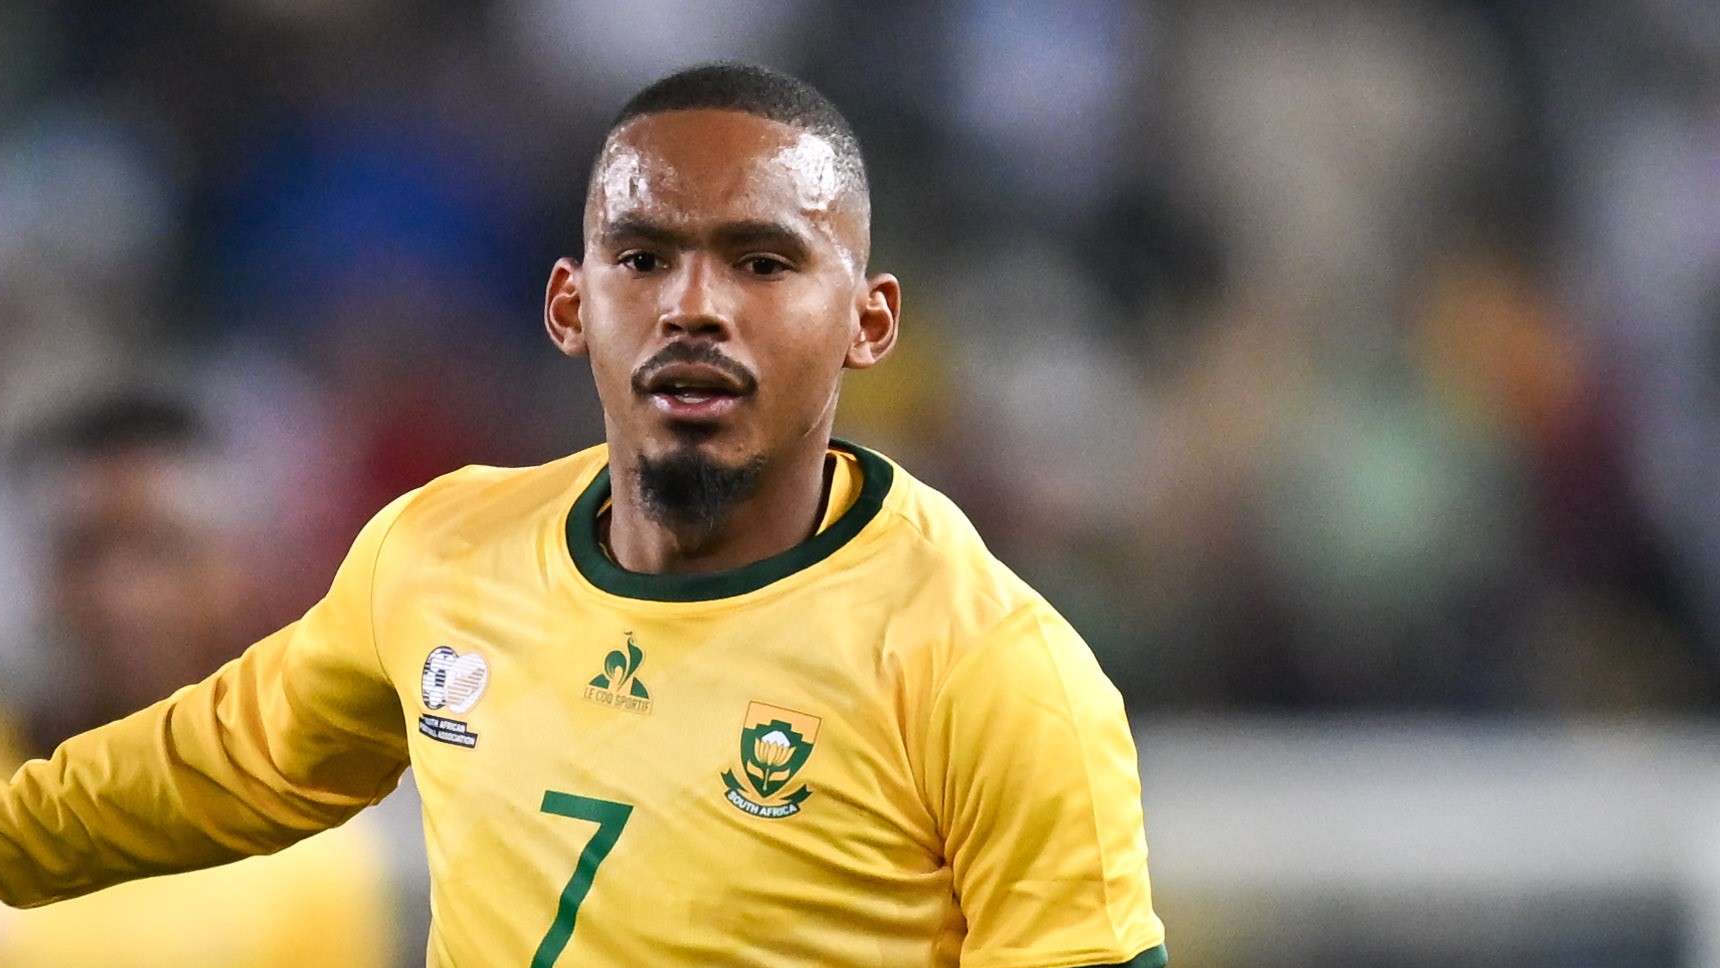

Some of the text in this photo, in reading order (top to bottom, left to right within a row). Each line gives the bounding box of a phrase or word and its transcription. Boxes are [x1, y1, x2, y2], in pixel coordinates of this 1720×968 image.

[583, 687, 595, 700] LE
[728, 791, 798, 817] SOUTH AFRICA
